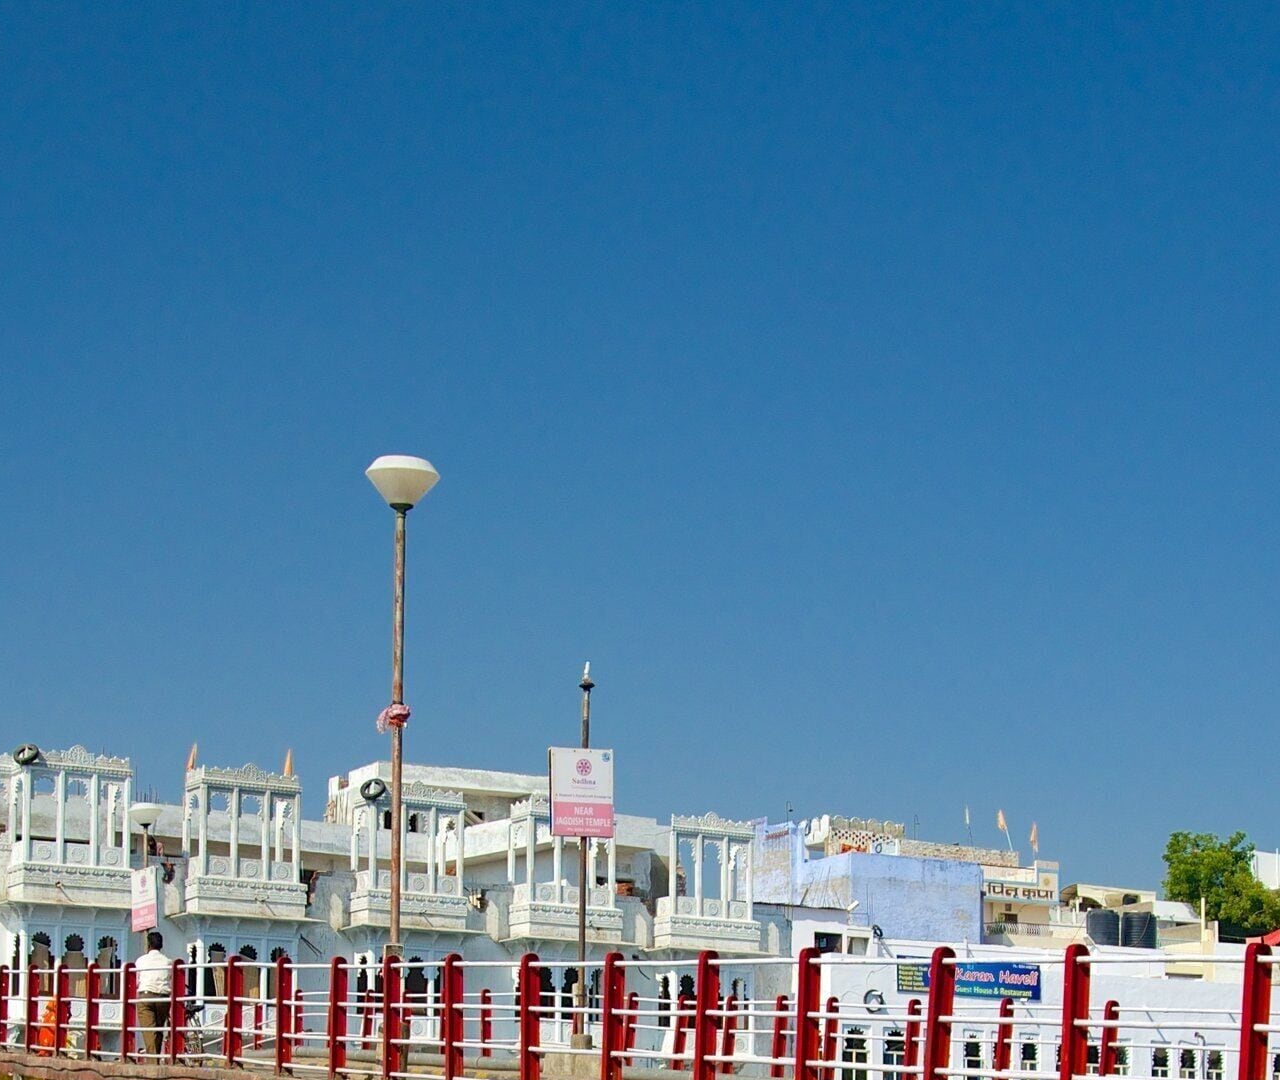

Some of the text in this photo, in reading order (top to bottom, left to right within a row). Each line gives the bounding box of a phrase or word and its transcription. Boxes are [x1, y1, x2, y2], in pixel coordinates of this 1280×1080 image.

[574, 806, 594, 816] NEAR
[555, 816, 611, 827] JAGDISH TEMPLE
[955, 967, 1039, 986] Karan Haveli
[955, 985, 972, 993] Guest
[973, 986, 993, 995] House
[1000, 988, 1032, 997] Restaurant
